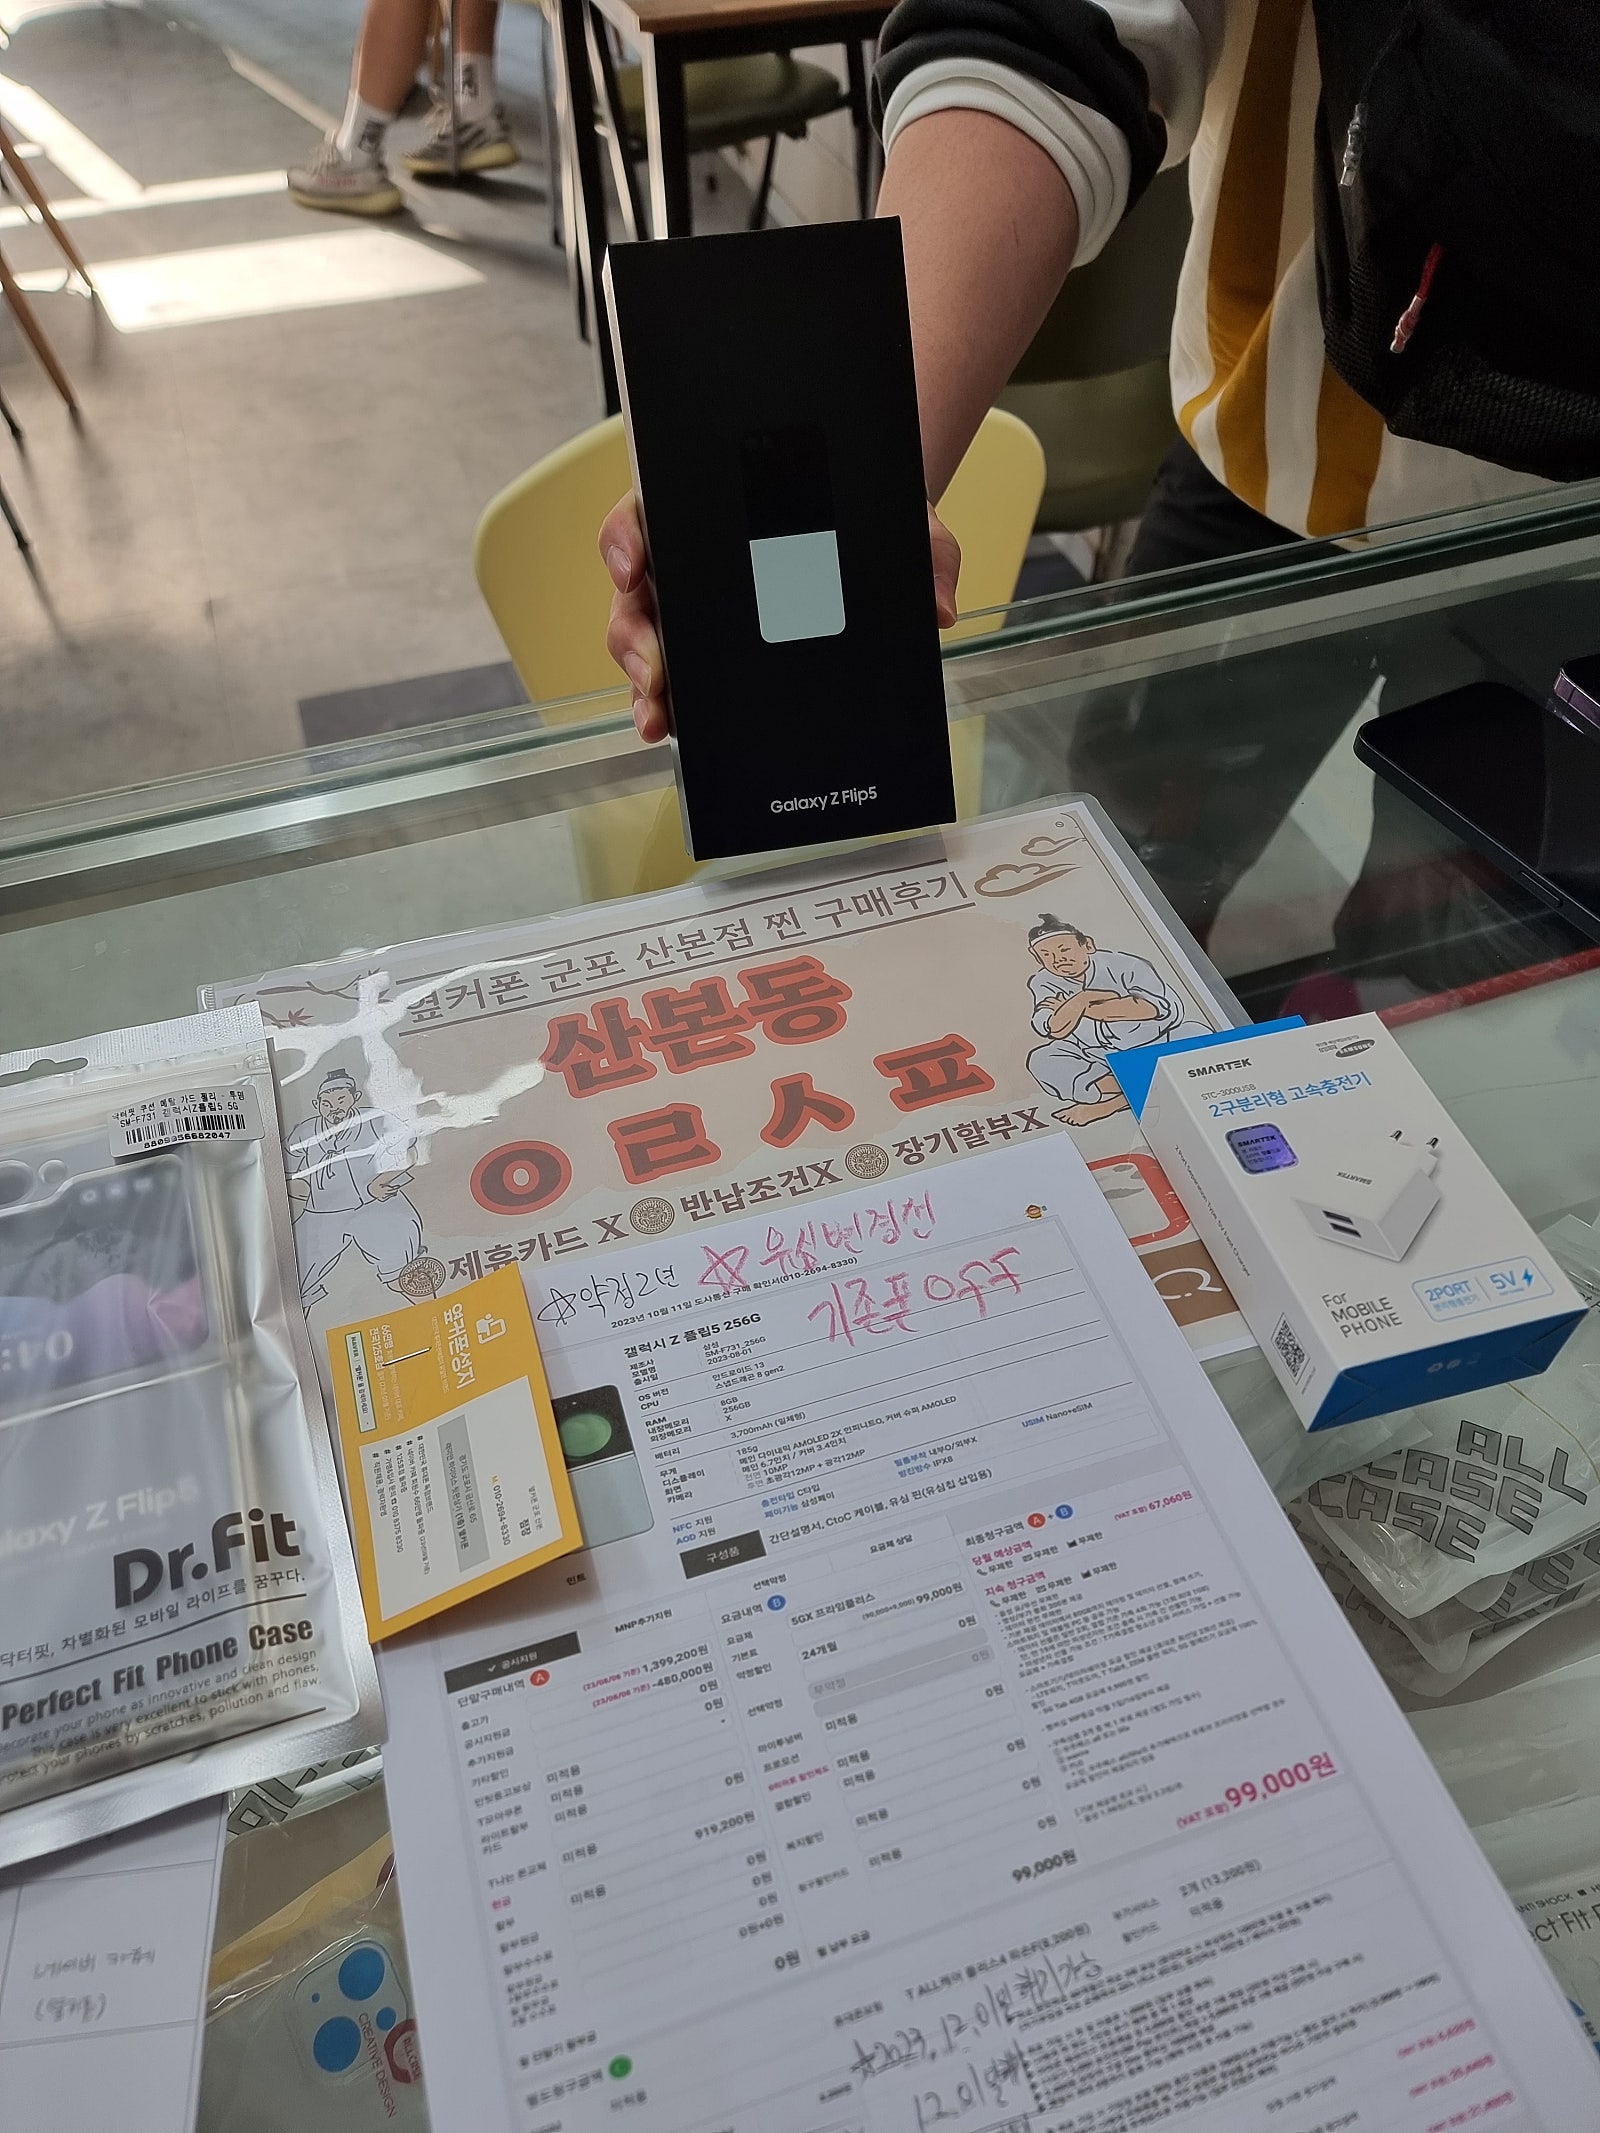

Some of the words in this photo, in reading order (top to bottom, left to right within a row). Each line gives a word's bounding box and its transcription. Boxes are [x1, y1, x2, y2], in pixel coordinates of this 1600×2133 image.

[770, 793, 828, 814] Galaxy
[829, 791, 840, 805] Z
[841, 786, 878, 806] Flip5
[540, 952, 627, 994] 군포
[637, 919, 754, 971] 산본점
[765, 908, 807, 942] 찐
[813, 871, 969, 930] 구매후기
[540, 954, 854, 1098] 산본동
[1187, 1058, 1252, 1078] SMARTEK
[181, 1093, 197, 1104] 가드
[1200, 1083, 1256, 1101] STC-3000USB
[1208, 1090, 1288, 1118] 2구분리형
[1288, 1071, 1372, 1101] 고속충전기
[120, 1113, 156, 1128] SM-F731
[227, 1101, 239, 1111] 5G
[892, 1105, 1050, 1167] 장기할부X
[679, 1158, 844, 1222] 반납조건X
[449, 1224, 590, 1285] 제휴카드
[598, 1213, 629, 1245] X
[1322, 1292, 1347, 1308] For
[1424, 1280, 1472, 1302] 2PORT
[1489, 1270, 1517, 1291] 5V
[611, 1313, 645, 1329] 2023년
[647, 1307, 670, 1320] 10월
[671, 1300, 693, 1313] 11일
[1330, 1297, 1393, 1322] MOBILE
[1340, 1312, 1403, 1339] PHONE
[351, 1336, 359, 1358] NAVER
[624, 1337, 667, 1359] 갤럭시
[670, 1334, 681, 1346] Z
[683, 1323, 721, 1342] 플립5
[723, 1312, 762, 1331] 256G
[629, 1359, 654, 1371] 제조사
[702, 1340, 720, 1351] 삼성
[631, 1366, 656, 1379] 모델명
[633, 1373, 659, 1386] 출시일
[706, 1348, 753, 1366] 2023-08-01
[638, 1391, 651, 1402] OS
[652, 1387, 670, 1399] 버전
[712, 1366, 753, 1382] 안드로이드
[753, 1361, 765, 1371] 13
[640, 1400, 660, 1411] CPU
[714, 1374, 756, 1390] 스냅드래곤
[764, 1364, 785, 1378] gen2
[645, 1416, 668, 1428] RAM
[720, 1395, 739, 1407] 8GB
[647, 1418, 691, 1436] 내장메모리
[723, 1400, 752, 1415] 256GB
[650, 1425, 693, 1443] 외장메모리
[655, 1447, 681, 1460] 배터리
[730, 1421, 775, 1440] 3,700mAh
[774, 1411, 807, 1429] (일체형)
[662, 1468, 706, 1487] 디스플레이
[738, 1454, 757, 1466] 메인
[791, 1432, 830, 1451] AMOLED
[885, 1408, 902, 1421] 커버
[903, 1404, 920, 1417] 슈퍼
[921, 1395, 957, 1412] AMOLED
[659, 1467, 678, 1478] 무게
[736, 1445, 759, 1457] 185g
[664, 1484, 683, 1496] 화면
[741, 1463, 759, 1474] 메인
[760, 1452, 792, 1469] 6.7인치
[816, 1435, 848, 1452] 3.4인치
[765, 1463, 816, 1485] 초광각12MP
[823, 1448, 866, 1468] 광각12MP
[797, 1483, 821, 1497] C타입
[1021, 1415, 1046, 1429] USIM
[1456, 1420, 1587, 1506] ALL
[666, 1490, 694, 1504] 카메라
[763, 1462, 790, 1476] 10MP
[86, 1502, 109, 1531] Z
[494, 1485, 511, 1546] 010-2694-8330
[520, 1518, 531, 1536] 점장
[672, 1521, 693, 1534] NFC
[694, 1515, 714, 1528] 지원
[801, 1491, 836, 1508] 삼성페이
[706, 1545, 740, 1564] 구성품
[768, 1520, 825, 1545] 간단설명서,
[826, 1512, 853, 1528] CtoC
[854, 1501, 889, 1519] 케이블,
[889, 1491, 910, 1507] 유심
[957, 1468, 993, 1486] 삽입용)
[964, 1521, 1025, 1547] 최종청구금액
[1148, 1490, 1193, 1511] 67,060원
[1308, 1474, 1487, 1563] CASE
[676, 1533, 697, 1546] AOD
[698, 1526, 717, 1540] 지원
[752, 1573, 787, 1591] 선택약정
[915, 1582, 965, 1605] 99,000원
[0, 1643, 55, 1669] 닥터핏,
[61, 1620, 127, 1651] 차별화된
[134, 1602, 180, 1630] 모바일
[186, 1577, 248, 1609] 라이프를
[253, 1568, 306, 1591] 꿈꾸다.
[720, 1604, 763, 1625] 요금내역
[790, 1612, 814, 1626] 5GX
[815, 1592, 876, 1618] 프라임플러스
[642, 1644, 709, 1674] 1,399,200원
[801, 1641, 839, 1661] 24개월
[1, 1677, 103, 1731] Perfect
[113, 1664, 146, 1696] Fit
[156, 1636, 239, 1682] Phone
[248, 1619, 313, 1651] Case
[87, 1703, 128, 1727] phone
[149, 1675, 211, 1706] innovative
[215, 1669, 238, 1684] and
[242, 1658, 275, 1676] clean
[277, 1650, 317, 1666] design
[136, 1697, 196, 1724] excellent
[211, 1683, 241, 1699] stick
[242, 1674, 269, 1690] with
[272, 1663, 320, 1682] phones,
[457, 1678, 526, 1708] 단말구매내역
[651, 1662, 714, 1689] -480,000원
[144, 1708, 206, 1735] scratches,
[209, 1692, 264, 1717] pollution
[267, 1683, 290, 1699] and
[293, 1676, 322, 1690] flaw.
[1224, 1752, 1337, 1809] 99,000원
[1529, 1918, 1561, 1943] ct
[359, 2013, 384, 2069] CREATIVE
